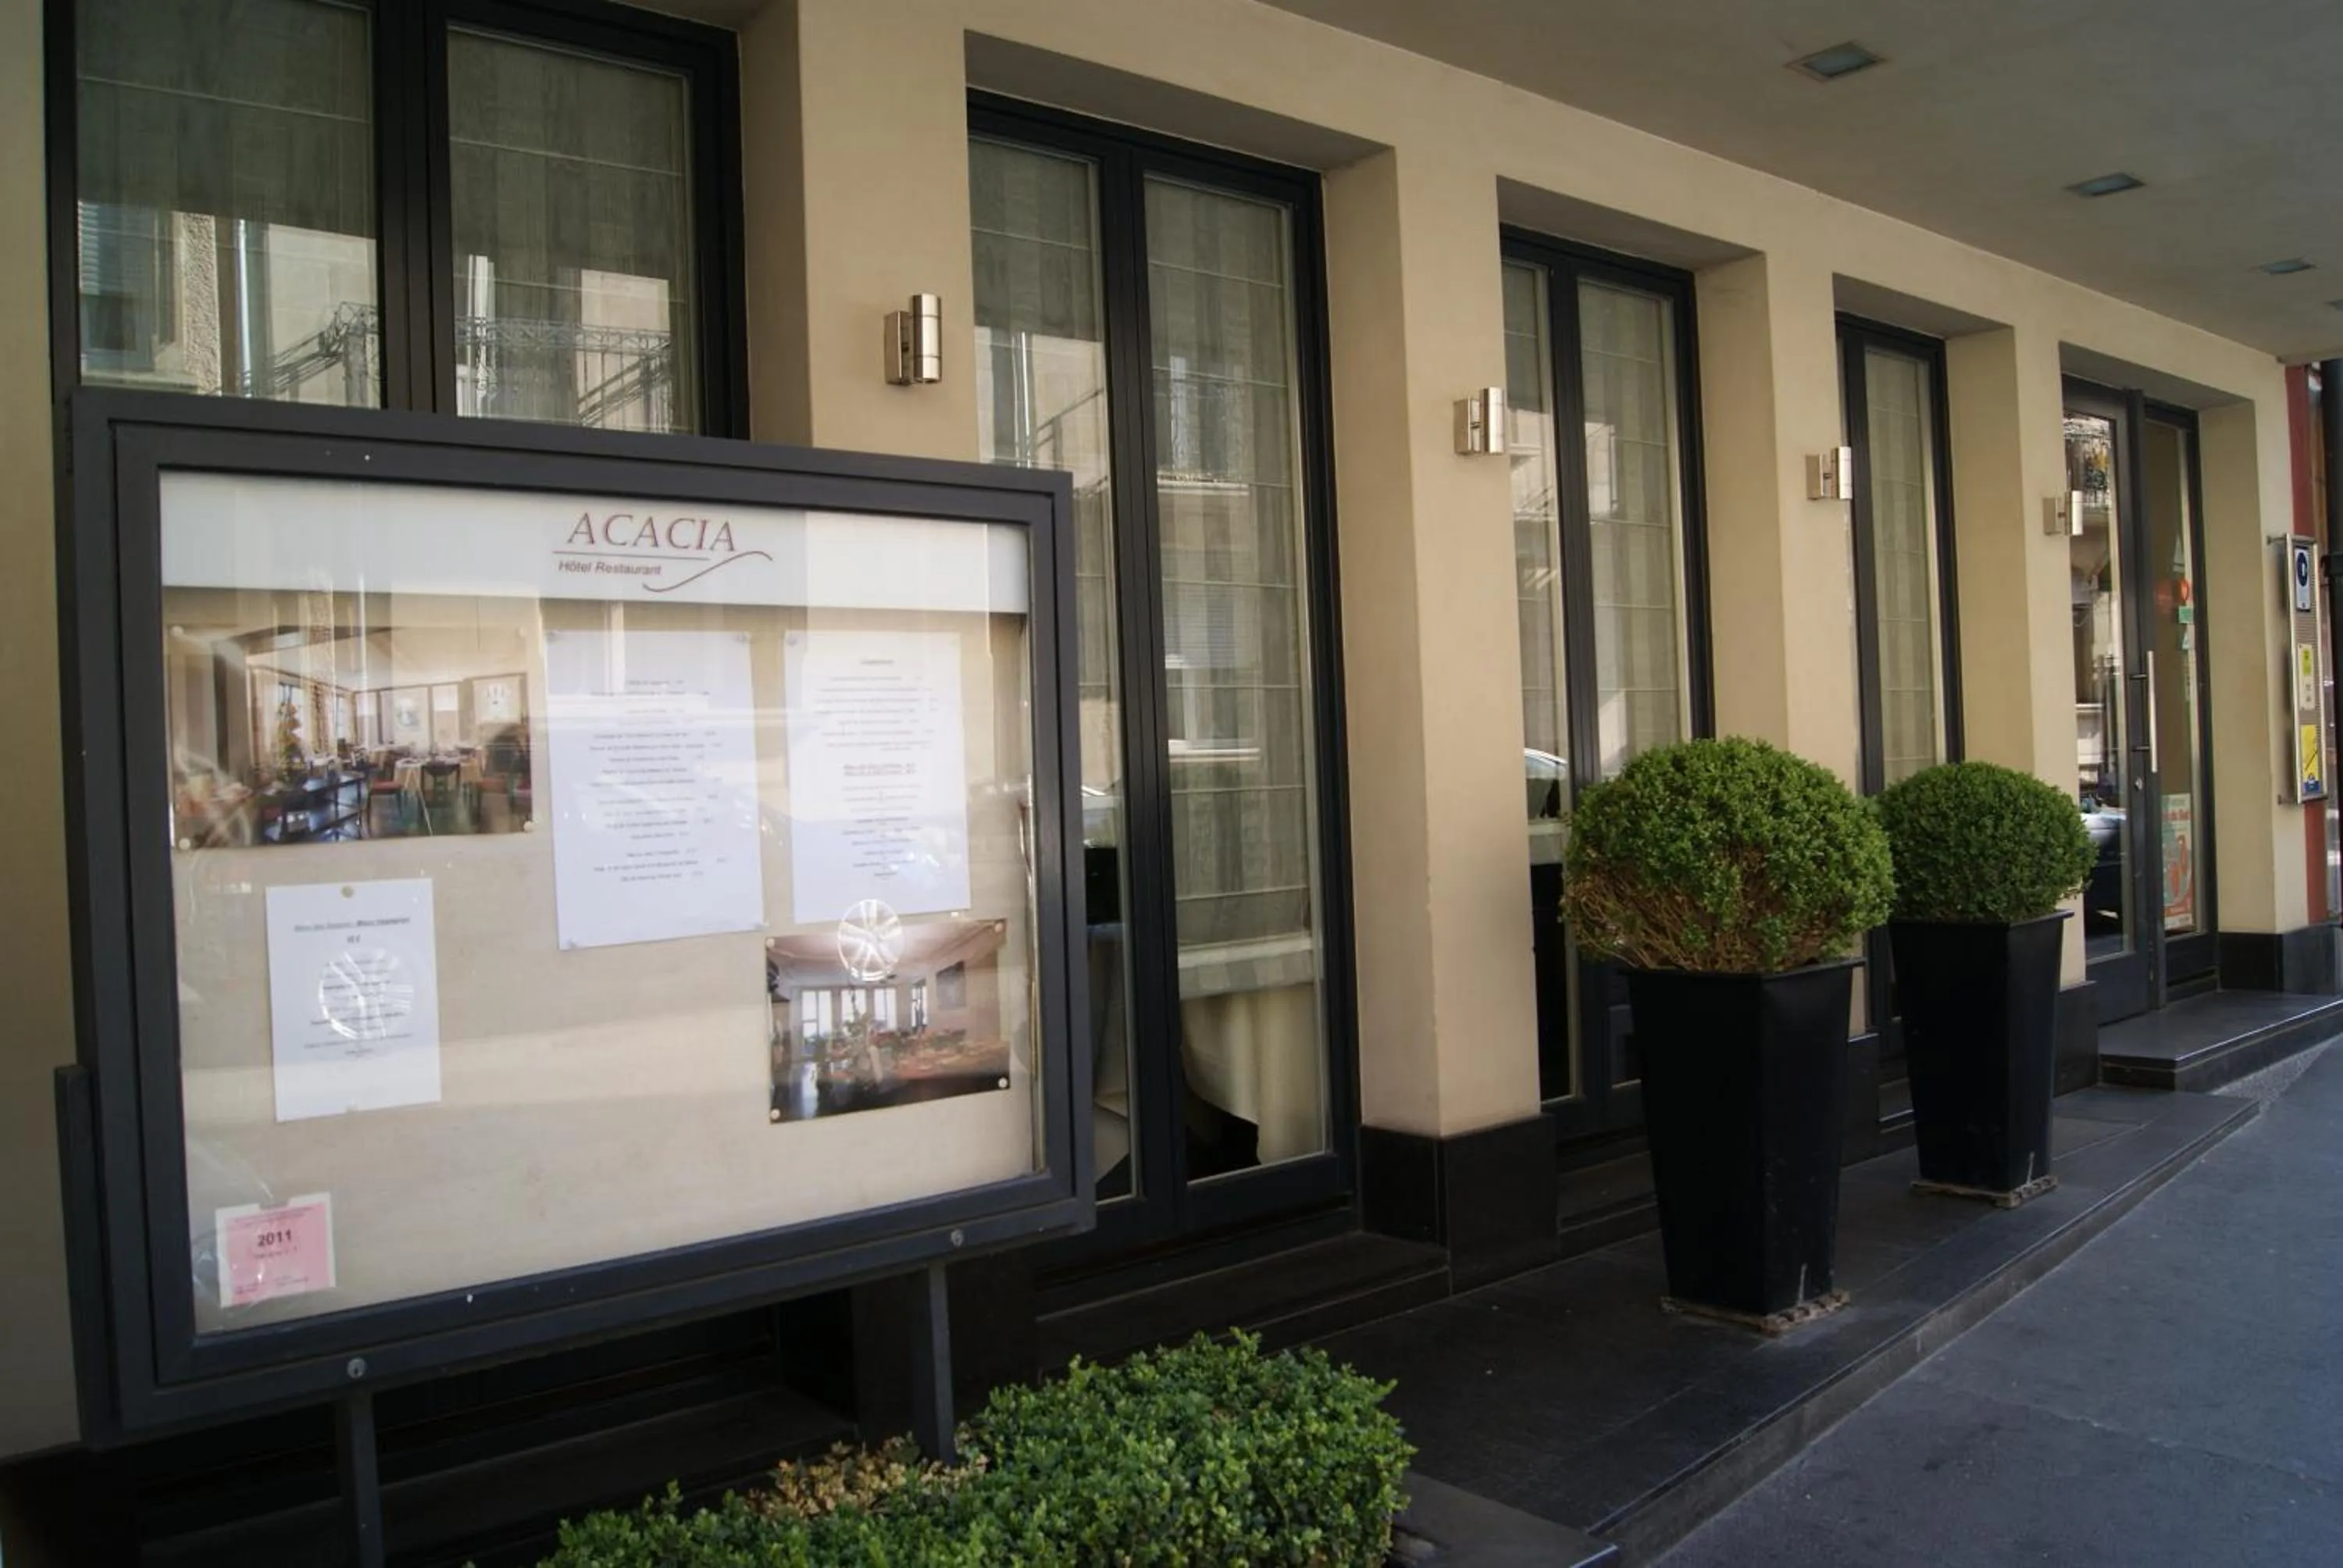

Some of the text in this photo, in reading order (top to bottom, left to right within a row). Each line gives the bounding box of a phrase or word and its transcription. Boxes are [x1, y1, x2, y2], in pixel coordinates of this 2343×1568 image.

[567, 511, 736, 551] ACACIA
[558, 559, 662, 576] Hôtel Restaurant
[257, 1228, 292, 1248] 2011
